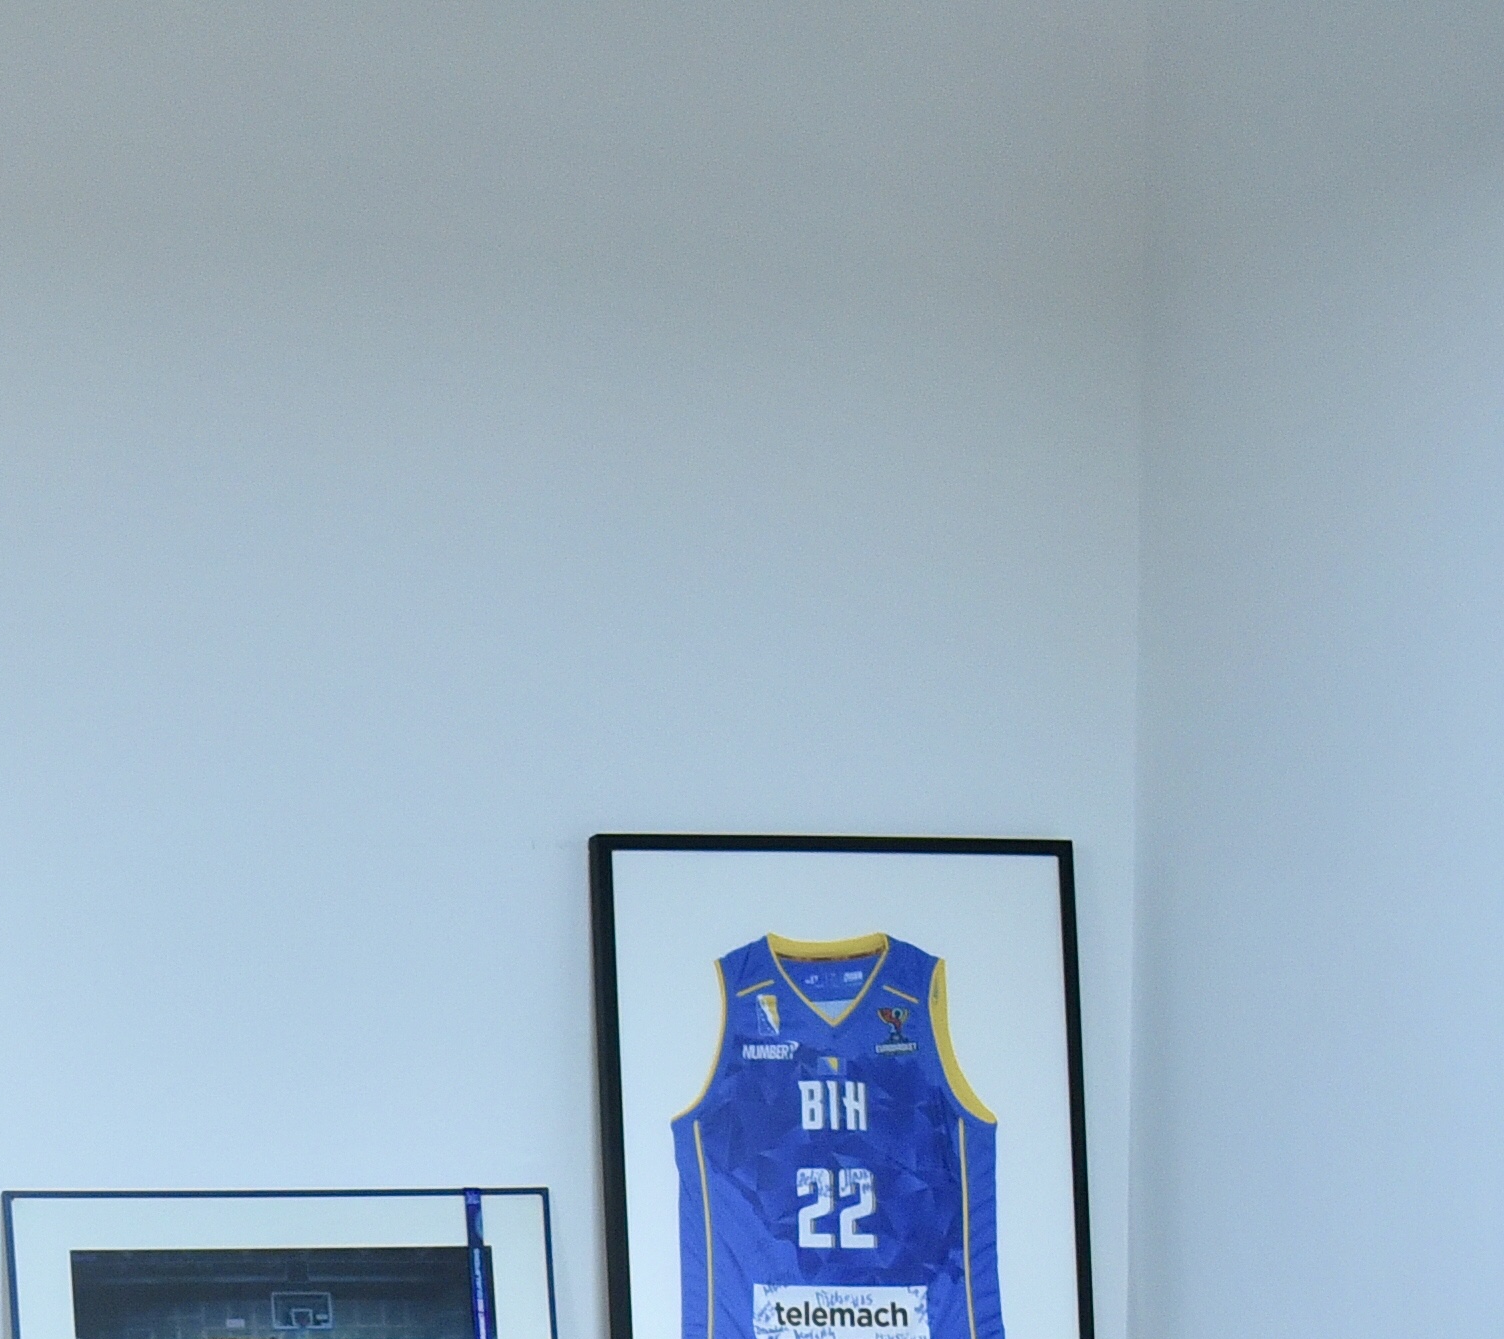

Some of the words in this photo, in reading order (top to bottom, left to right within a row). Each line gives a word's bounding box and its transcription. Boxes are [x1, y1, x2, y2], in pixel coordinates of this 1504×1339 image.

[798, 1080, 868, 1131] BIH
[796, 1168, 877, 1248] 22
[775, 1301, 909, 1327] telemach
